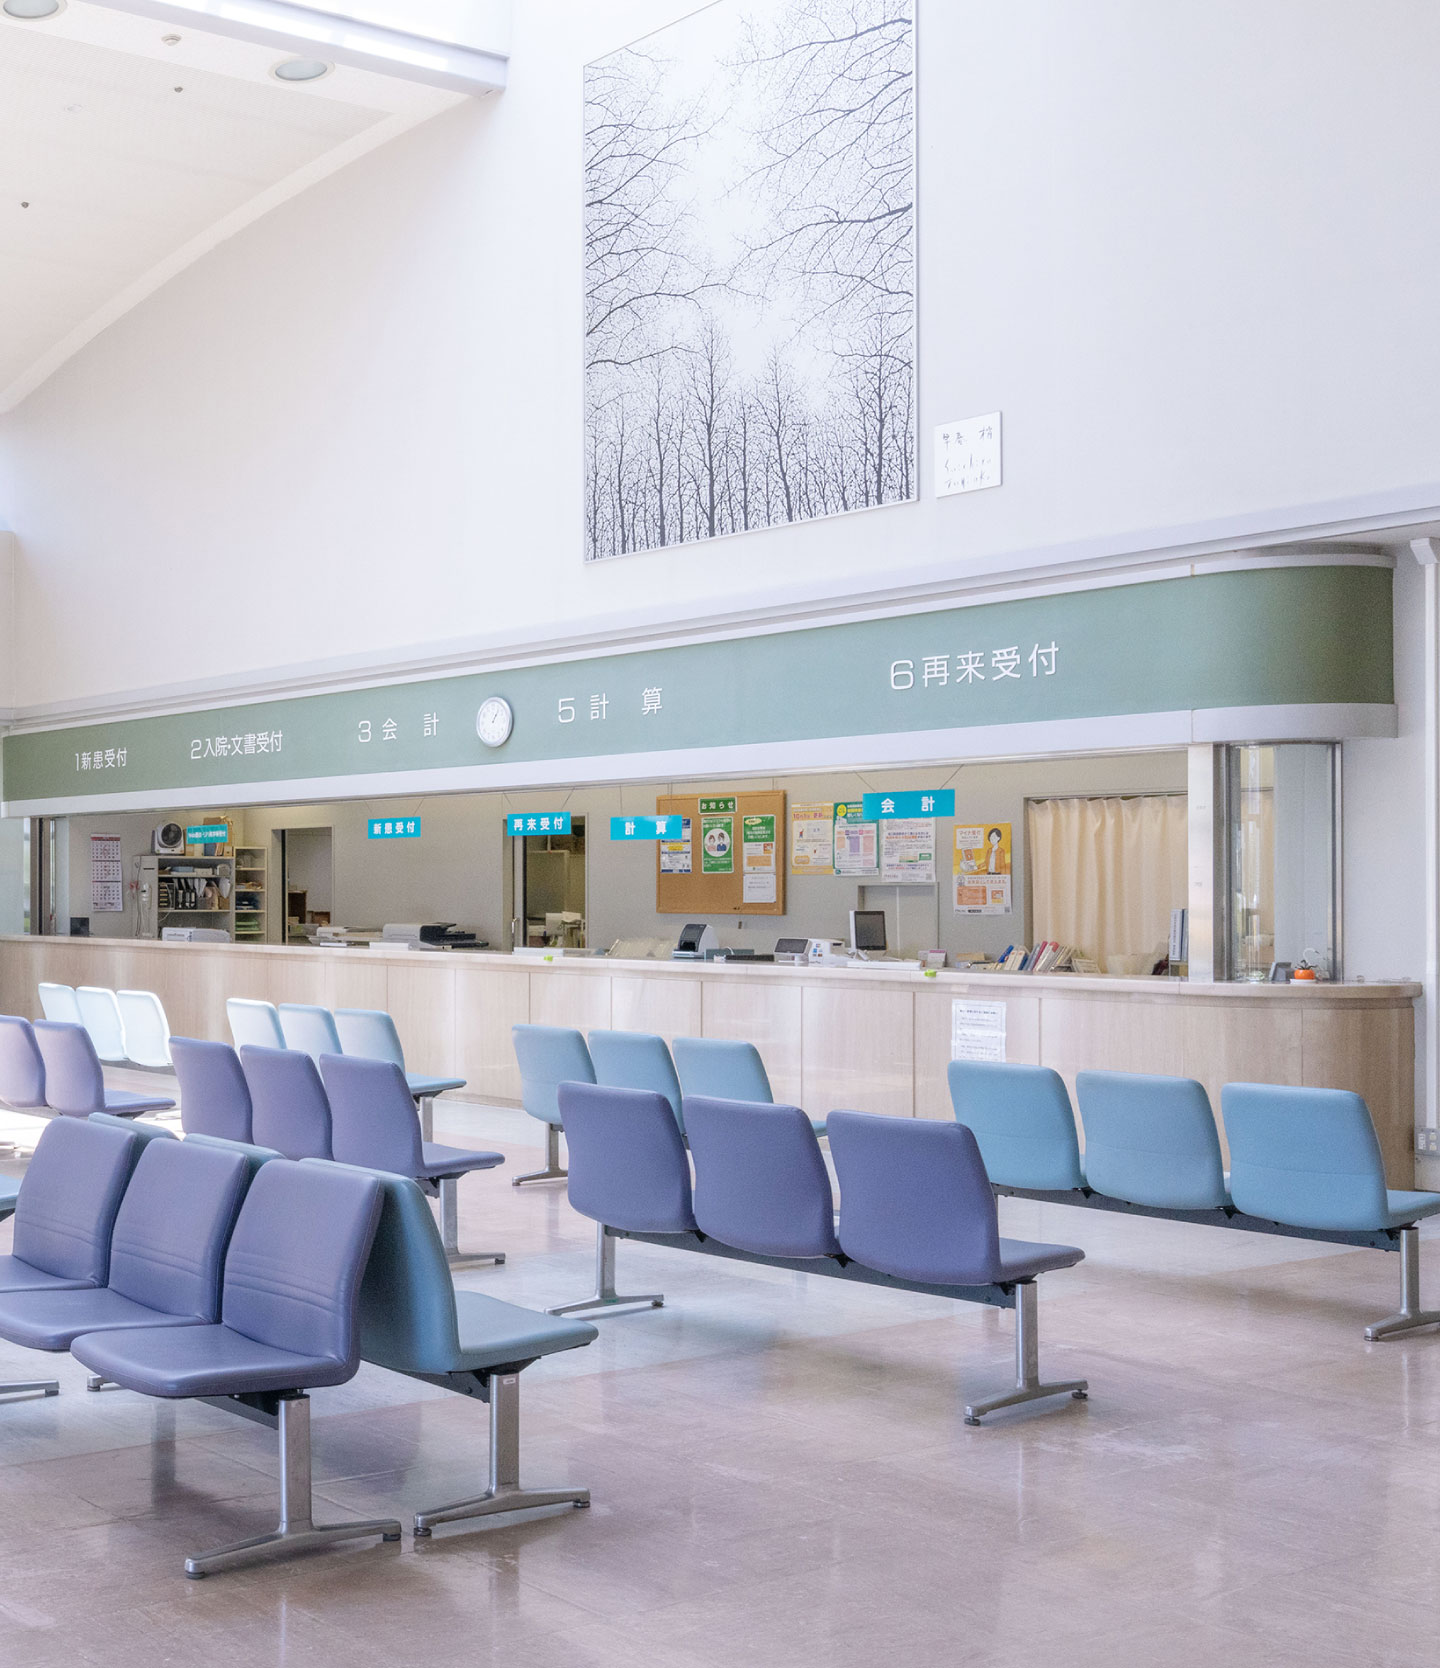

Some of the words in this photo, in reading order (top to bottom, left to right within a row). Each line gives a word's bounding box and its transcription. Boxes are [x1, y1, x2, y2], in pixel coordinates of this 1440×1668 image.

[890, 641, 1060, 690] 6再来受付
[74, 747, 128, 771] 1新患受付
[701, 801, 734, 810] お知らせ
[881, 796, 935, 814] 会計
[373, 820, 416, 835] 新患受付
[513, 816, 564, 831] 再来受付
[625, 820, 668, 836] 計算
